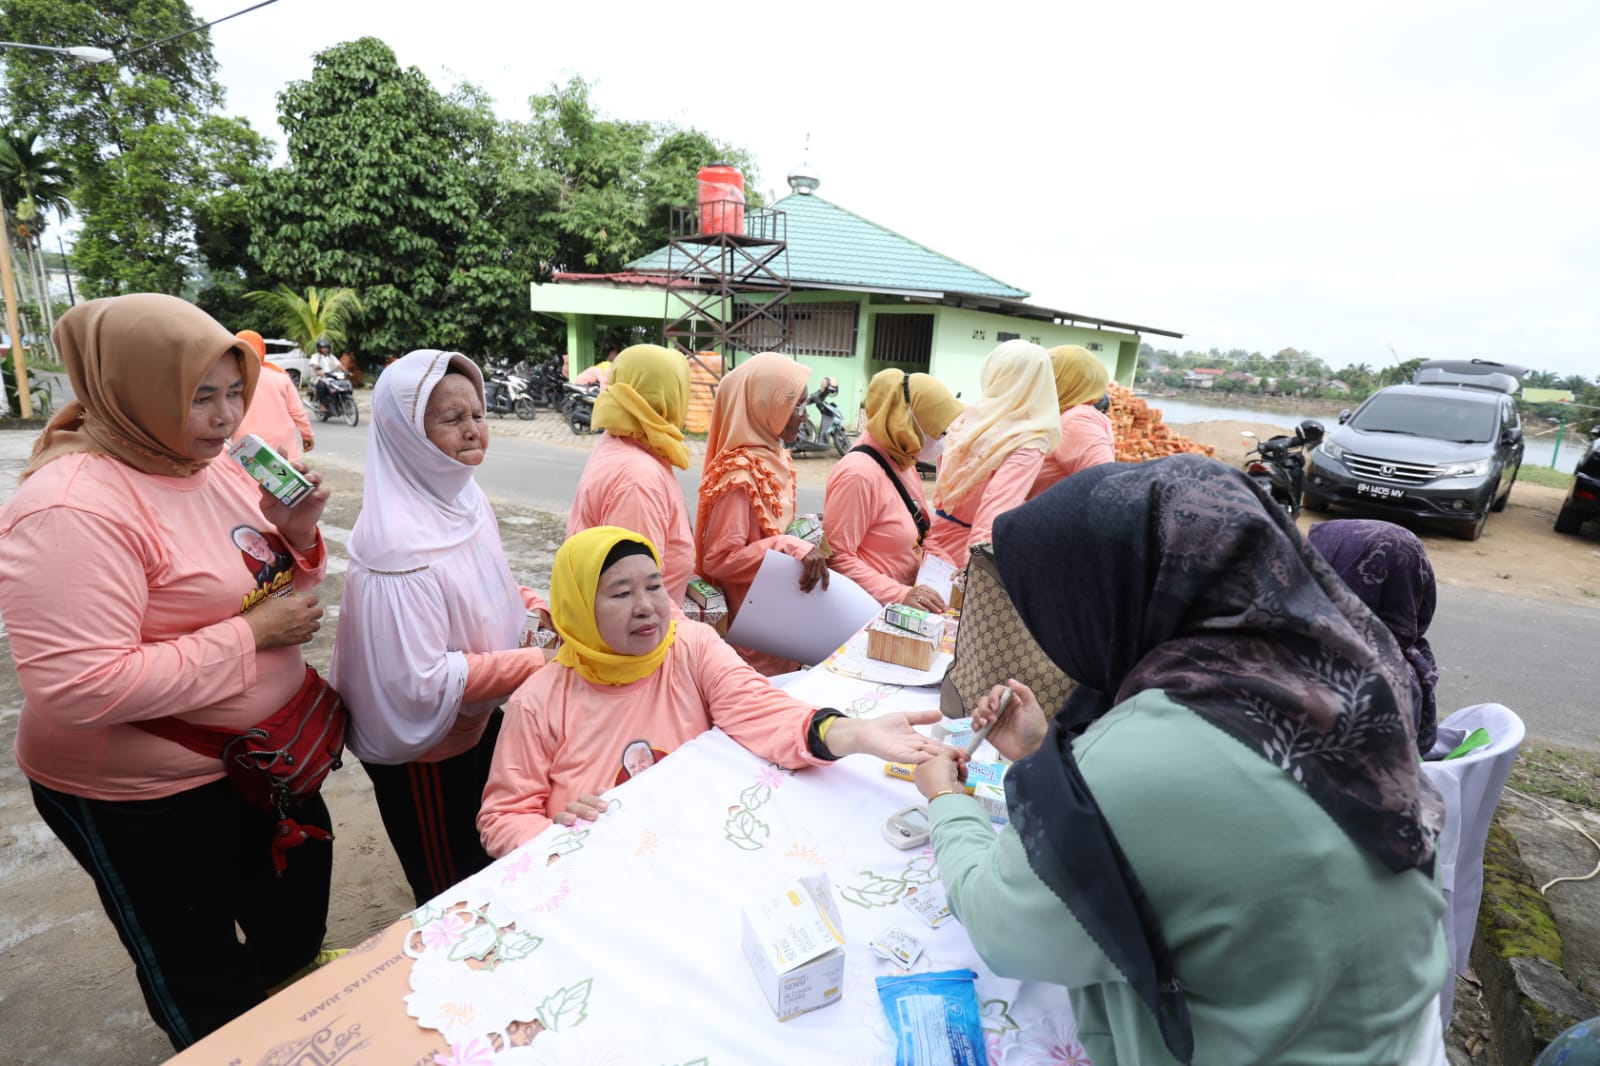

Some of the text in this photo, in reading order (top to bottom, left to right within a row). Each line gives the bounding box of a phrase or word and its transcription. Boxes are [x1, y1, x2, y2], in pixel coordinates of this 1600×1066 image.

[1358, 483, 1369, 492] BH
[240, 581, 271, 613] Mak
[297, 954, 402, 1022] KUALITAS JUARA
